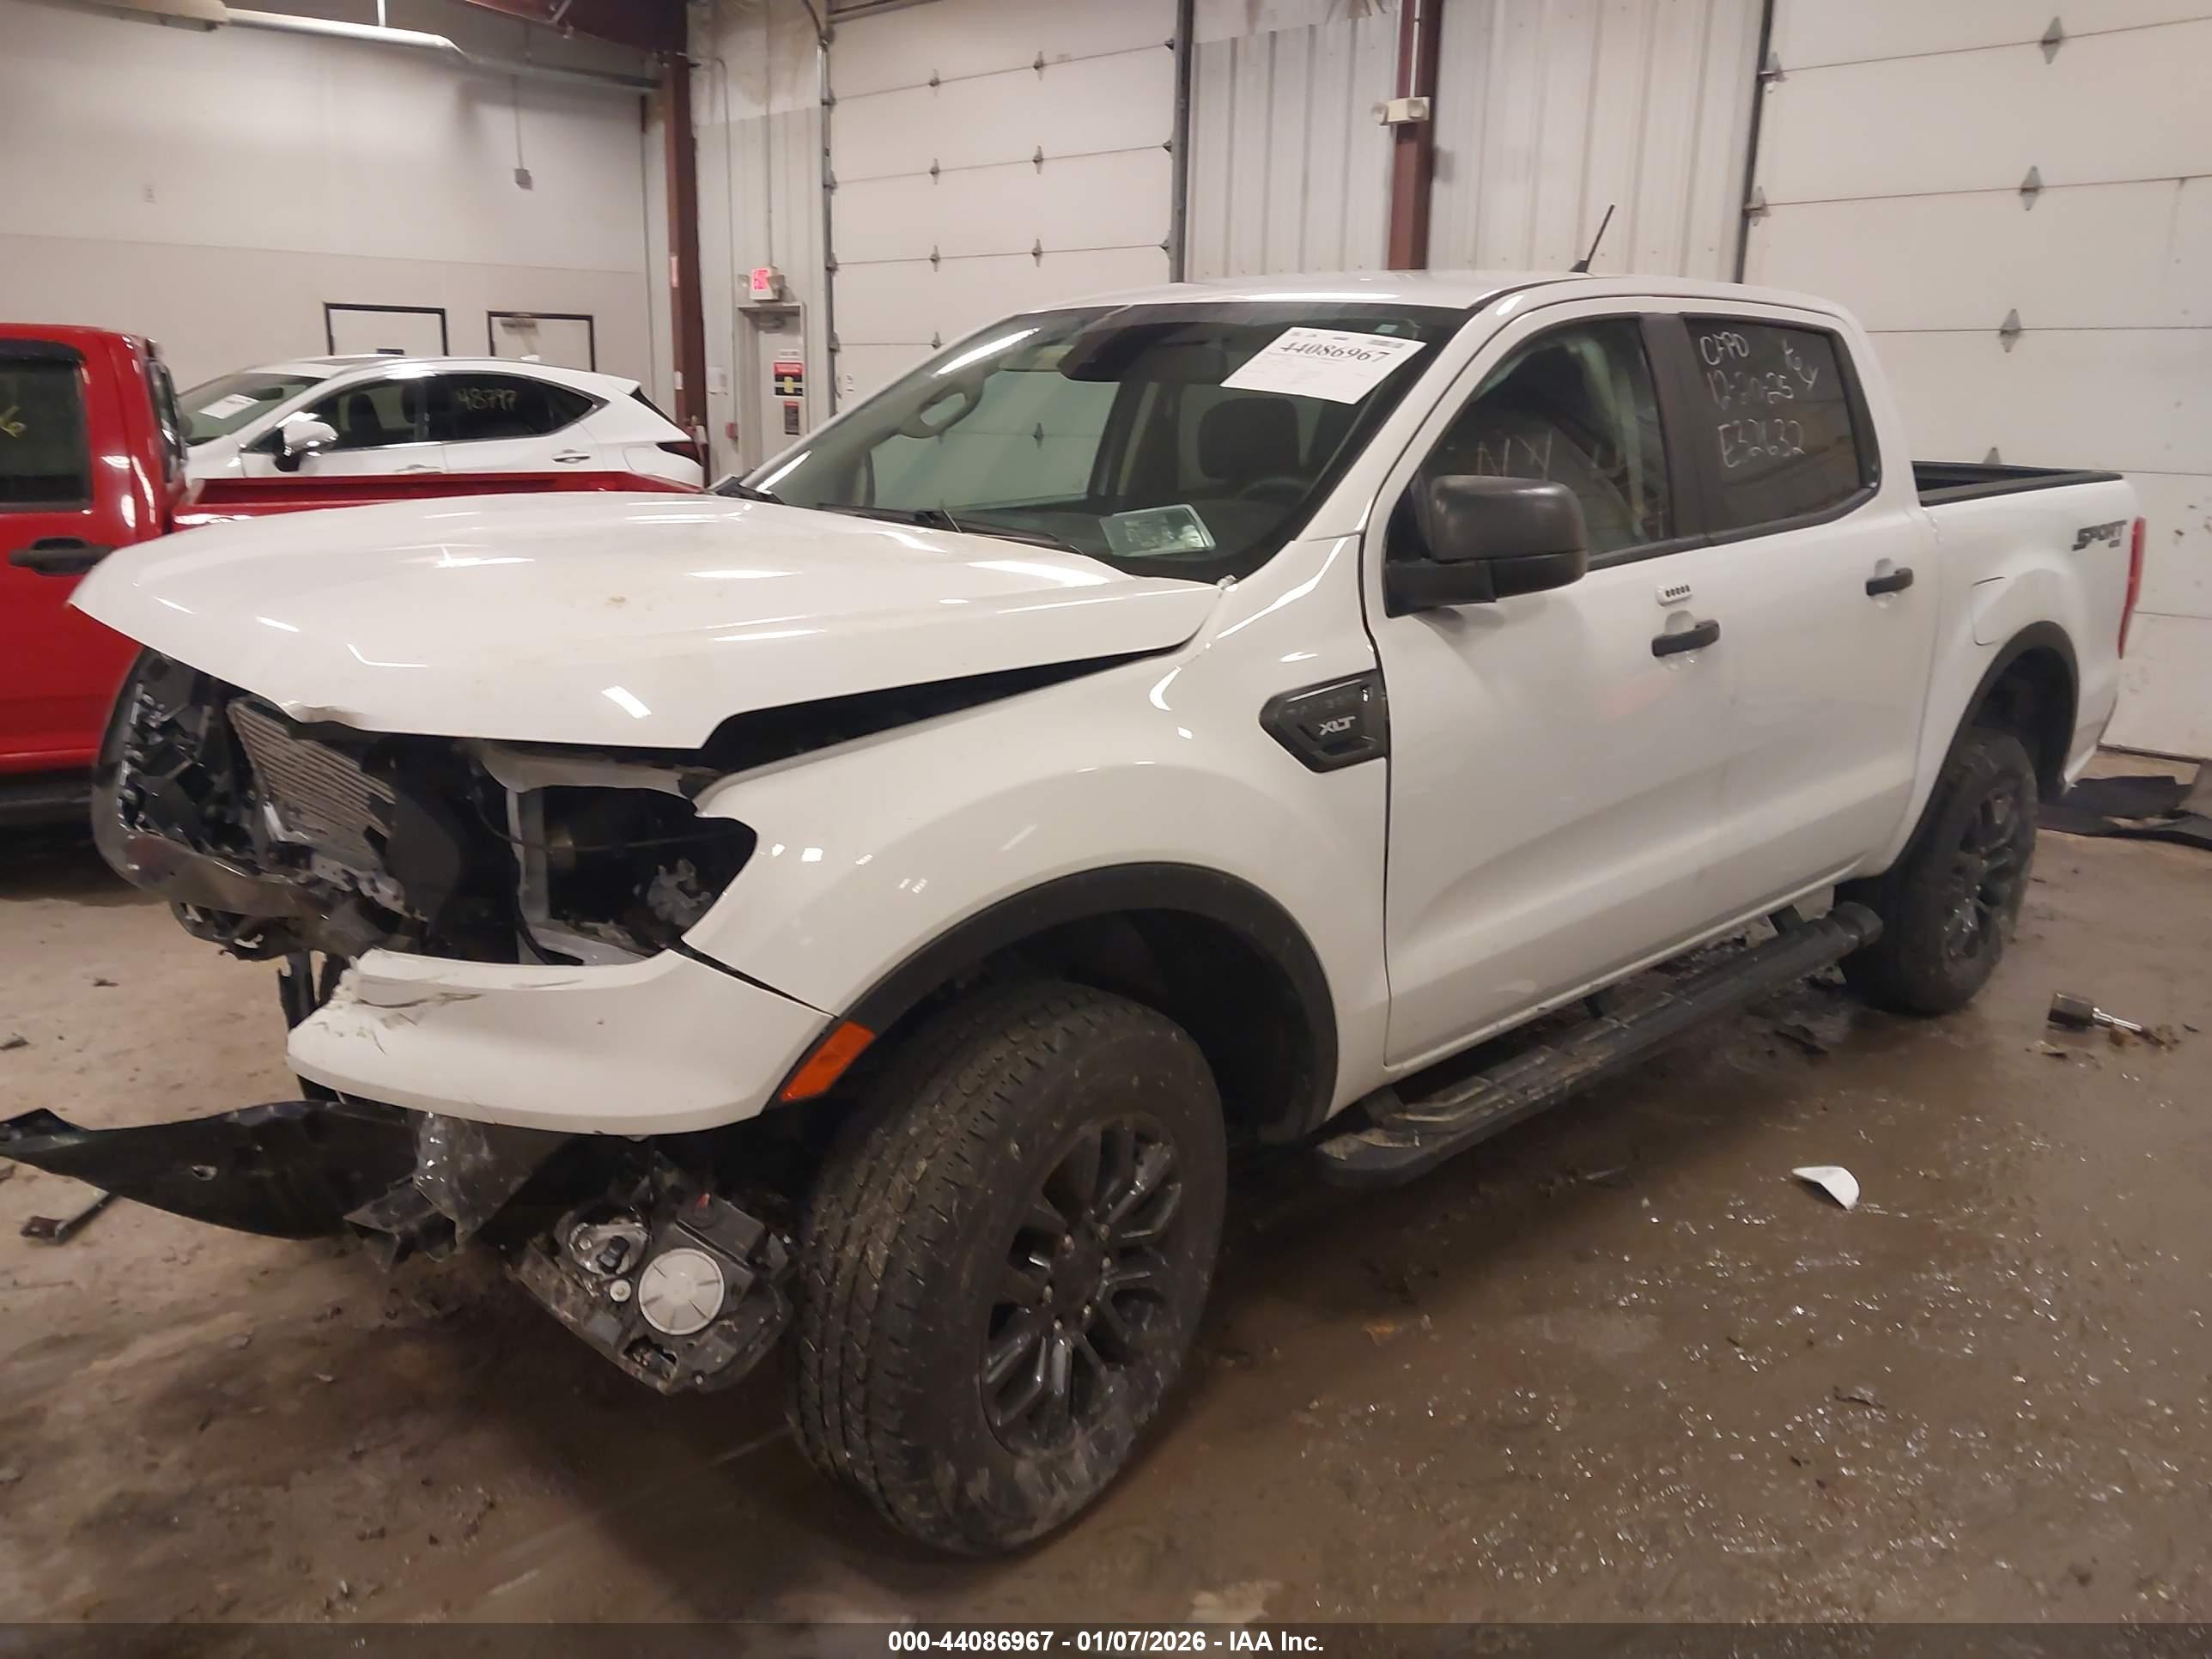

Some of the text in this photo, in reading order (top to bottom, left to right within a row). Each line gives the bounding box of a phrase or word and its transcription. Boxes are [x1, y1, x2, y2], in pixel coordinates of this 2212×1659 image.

[1279, 342, 1391, 363] 44086967
[2071, 518, 2129, 552] SPORT
[1319, 716, 1355, 735] XLT
